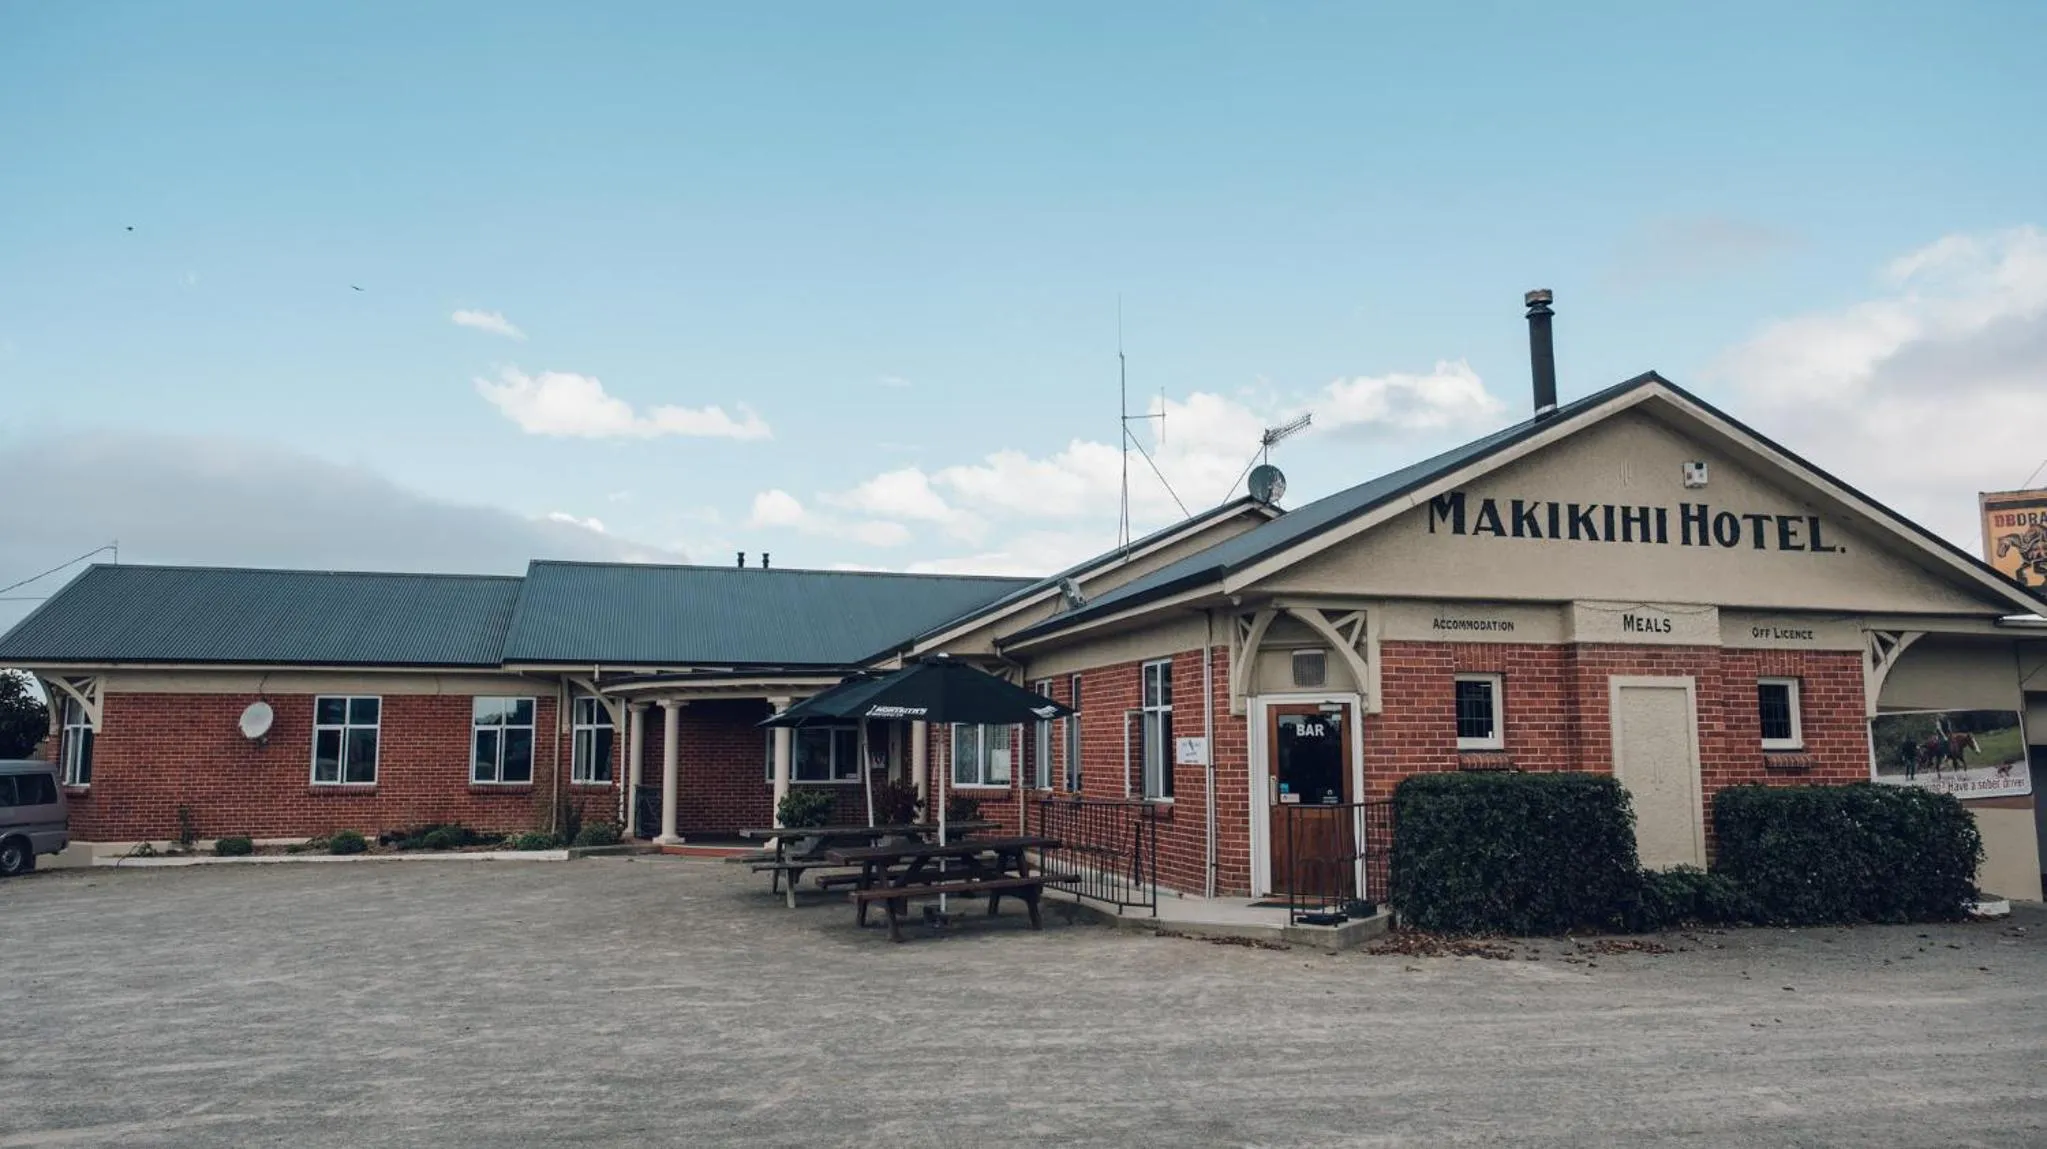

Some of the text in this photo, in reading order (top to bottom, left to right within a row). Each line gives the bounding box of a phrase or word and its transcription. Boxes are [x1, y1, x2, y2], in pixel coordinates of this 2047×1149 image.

[1429, 492, 1847, 554] MAKIKIHI HOTEL.
[1433, 618, 1515, 632] ACCOMMODATION
[1623, 614, 1671, 633] MEALS
[1752, 626, 1814, 640] OFF LICENCE
[1296, 723, 1325, 737] BAR
